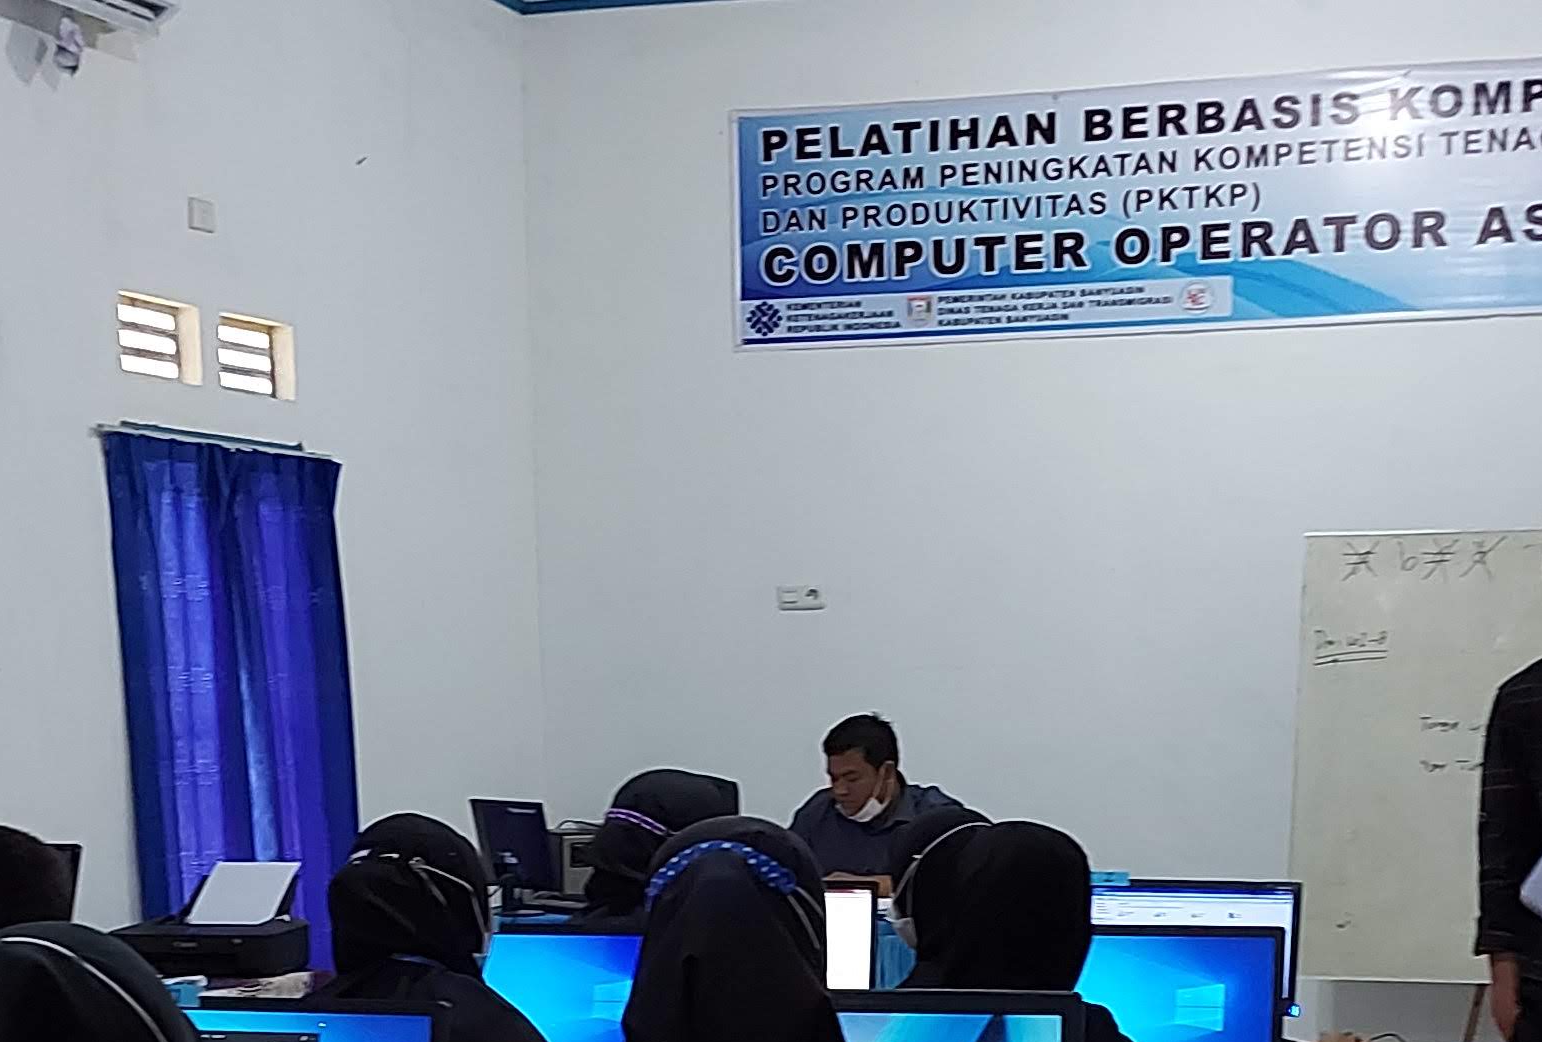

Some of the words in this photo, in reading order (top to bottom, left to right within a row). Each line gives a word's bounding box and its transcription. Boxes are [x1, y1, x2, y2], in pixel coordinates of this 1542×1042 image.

[762, 112, 1056, 161] PELATIHAN
[1084, 92, 1359, 141] BERBASIS
[762, 167, 924, 197] PROGRAM
[940, 150, 1177, 188] PENINGKATAN
[1194, 134, 1424, 170] KOMPETENSI
[762, 208, 826, 233] DAN
[842, 191, 1106, 229] PRODUKTIVITAS
[1122, 182, 1261, 218] (PKTKP)
[763, 231, 1088, 284] COMPUTER
[1115, 211, 1447, 265] OPERATOR
